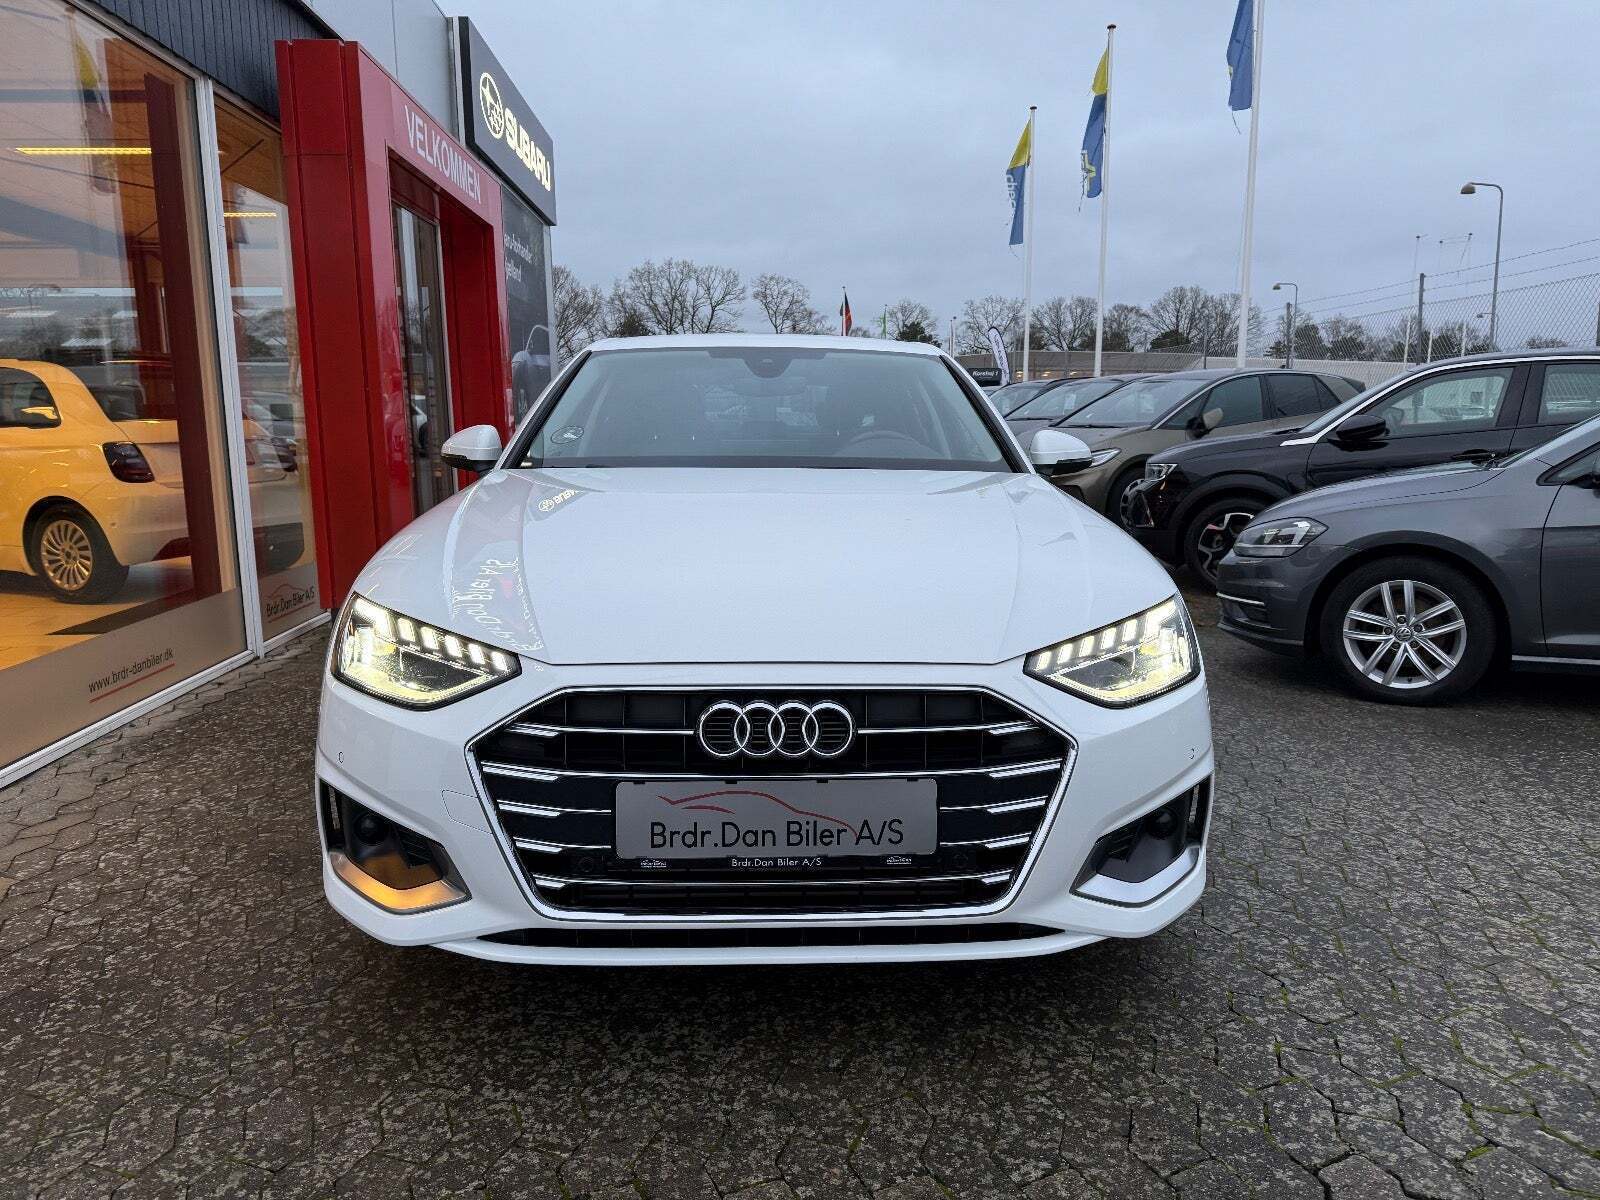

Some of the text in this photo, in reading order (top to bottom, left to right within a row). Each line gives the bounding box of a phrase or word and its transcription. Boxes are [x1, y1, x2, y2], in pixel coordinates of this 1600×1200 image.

[404, 104, 482, 205] VELKOMMEN
[504, 107, 551, 192] SUBARU
[88, 647, 174, 694] www.brdr-danbiler.dk
[650, 818, 904, 848] Brdr.Dan Biler A/S
[731, 857, 822, 868] Brdr.Dan Biler A/S
